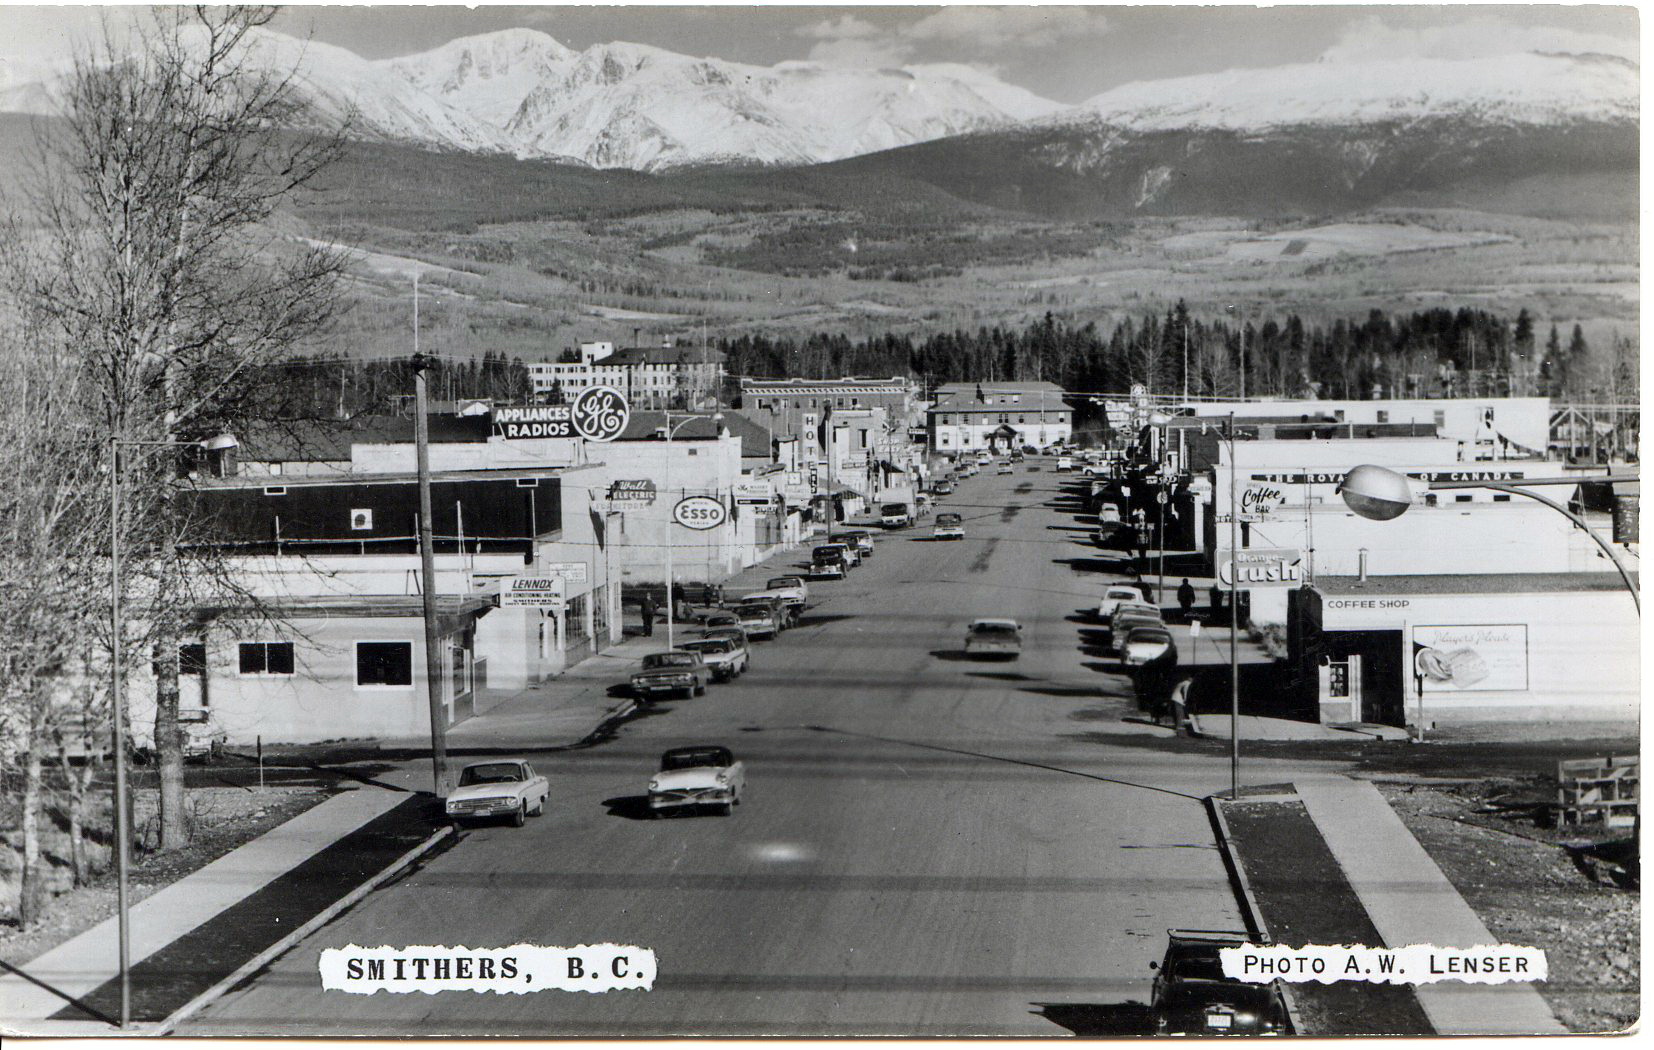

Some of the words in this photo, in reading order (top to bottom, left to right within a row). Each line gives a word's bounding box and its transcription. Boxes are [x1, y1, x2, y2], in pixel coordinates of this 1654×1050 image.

[495, 407, 570, 423] APPLIANCES
[508, 422, 570, 437] RADIOS
[1265, 474, 1294, 483] THE
[1307, 474, 1347, 483] ROYA
[1420, 473, 1438, 482] OF
[1451, 473, 1511, 481] CANADA
[620, 480, 647, 490] Wall
[613, 490, 655, 499] ELECTRIC
[1242, 487, 1281, 507] Coffee
[1255, 505, 1271, 513] BAR
[1220, 558, 1301, 586] Crush
[512, 579, 554, 589] LENNOX
[1327, 600, 1376, 609] COFFEE
[1379, 600, 1410, 609] SHOP
